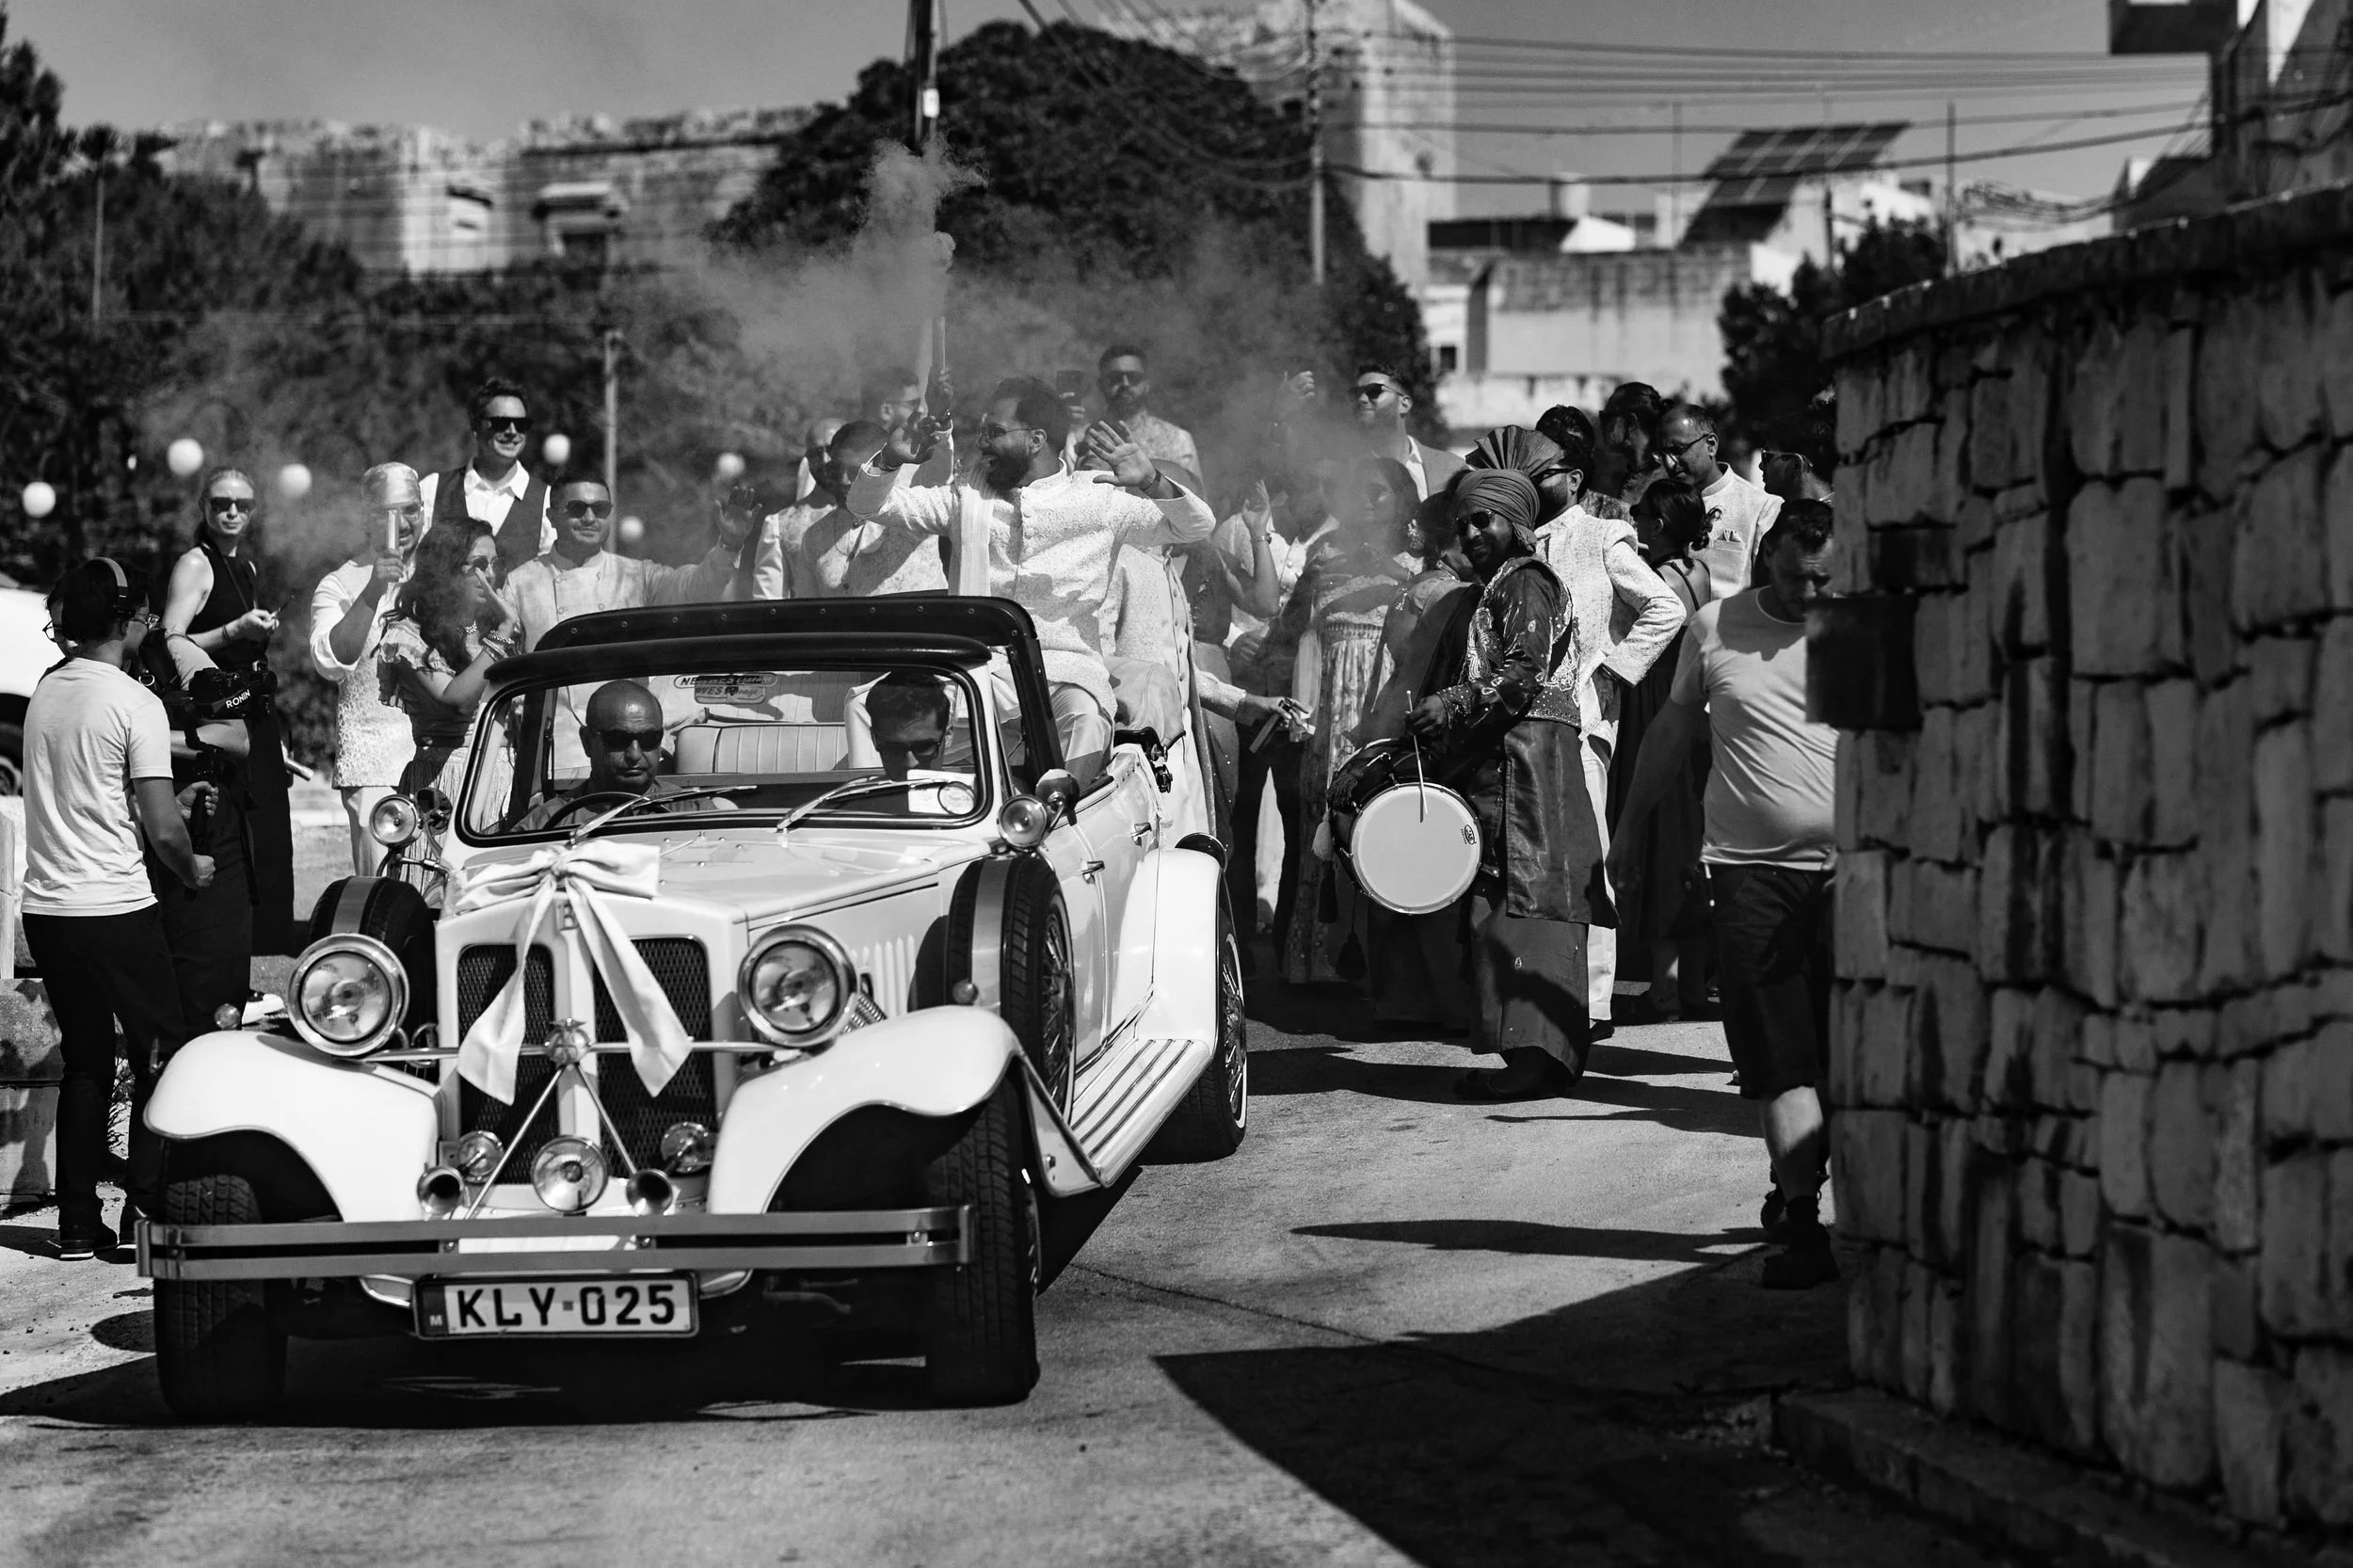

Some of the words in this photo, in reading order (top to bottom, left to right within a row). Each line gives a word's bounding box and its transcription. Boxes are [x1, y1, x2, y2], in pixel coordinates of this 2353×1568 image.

[225, 689, 250, 709] RONIN
[456, 1287, 556, 1329] KLY
[579, 1284, 676, 1327] 025
[429, 1314, 443, 1326] M
